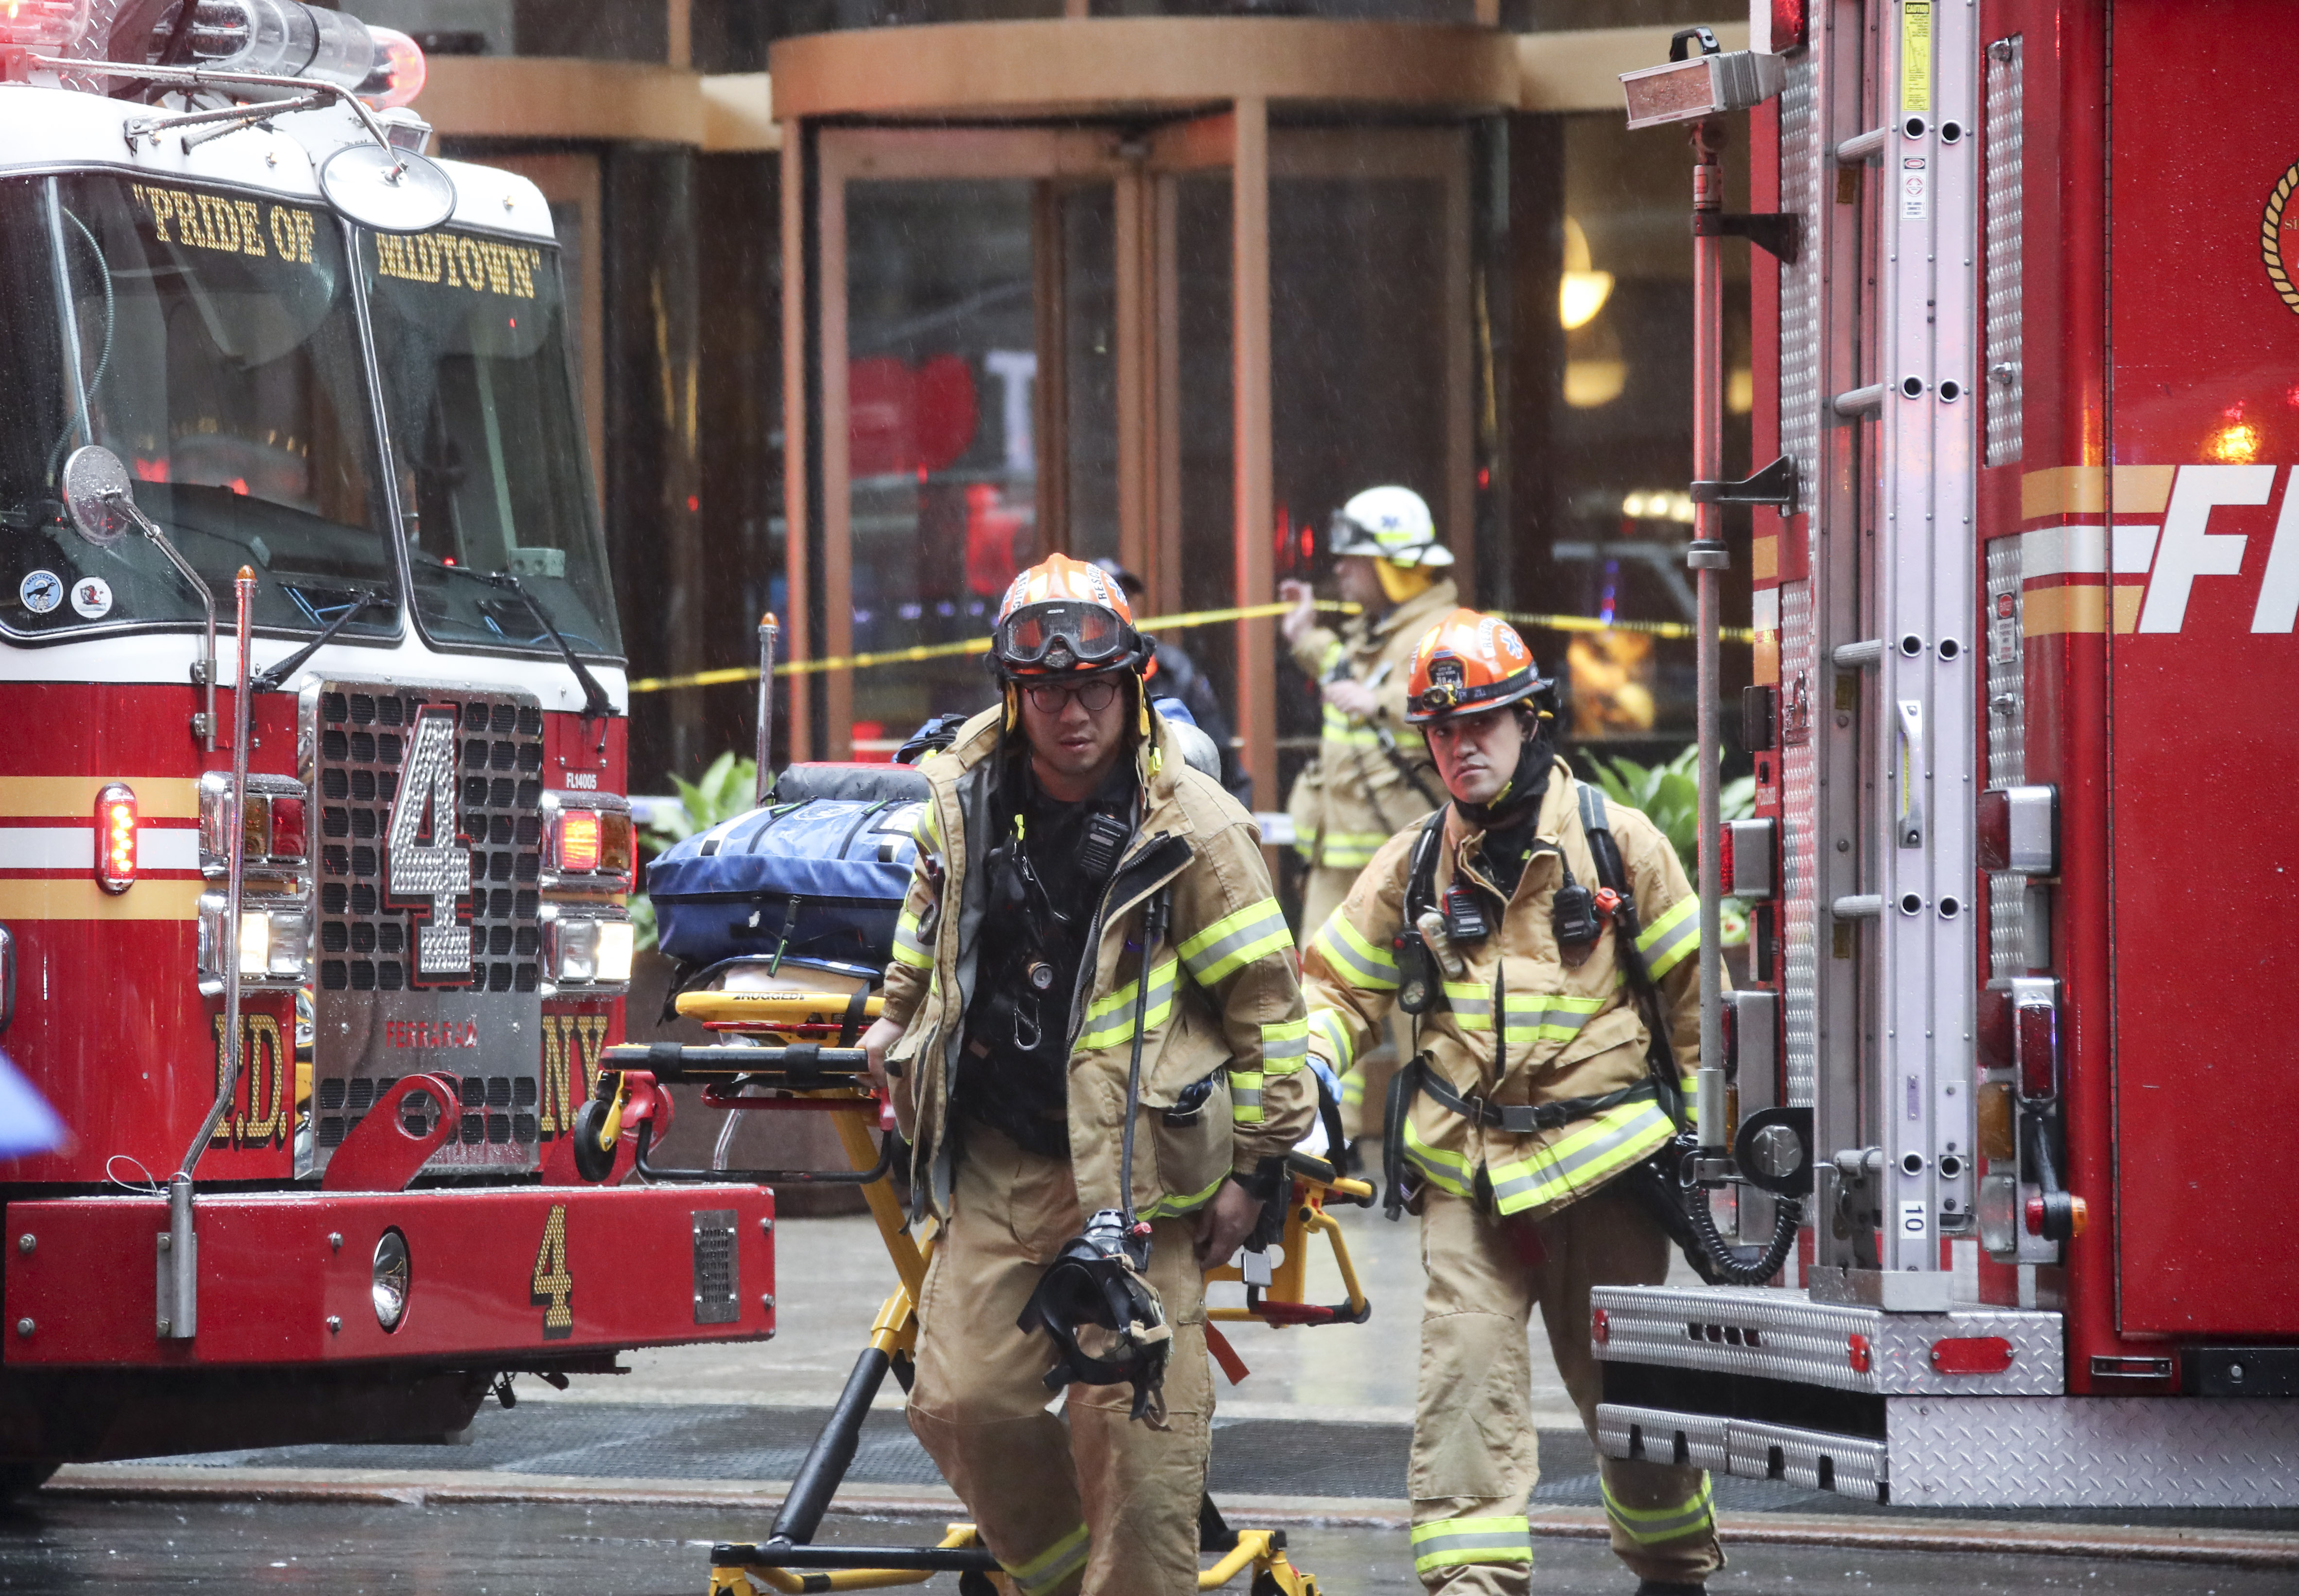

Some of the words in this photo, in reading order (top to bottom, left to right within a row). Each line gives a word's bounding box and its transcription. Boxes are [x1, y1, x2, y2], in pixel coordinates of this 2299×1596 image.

[132, 184, 267, 257] "PRIDE
[270, 205, 315, 264] OF
[376, 232, 541, 299] MIDTOWN"
[26, 576, 37, 586] SEAL
[566, 773, 597, 790] FL14005
[385, 705, 473, 986] 4
[1906, 1205, 1924, 1231] 10
[532, 1205, 572, 1333] 4
